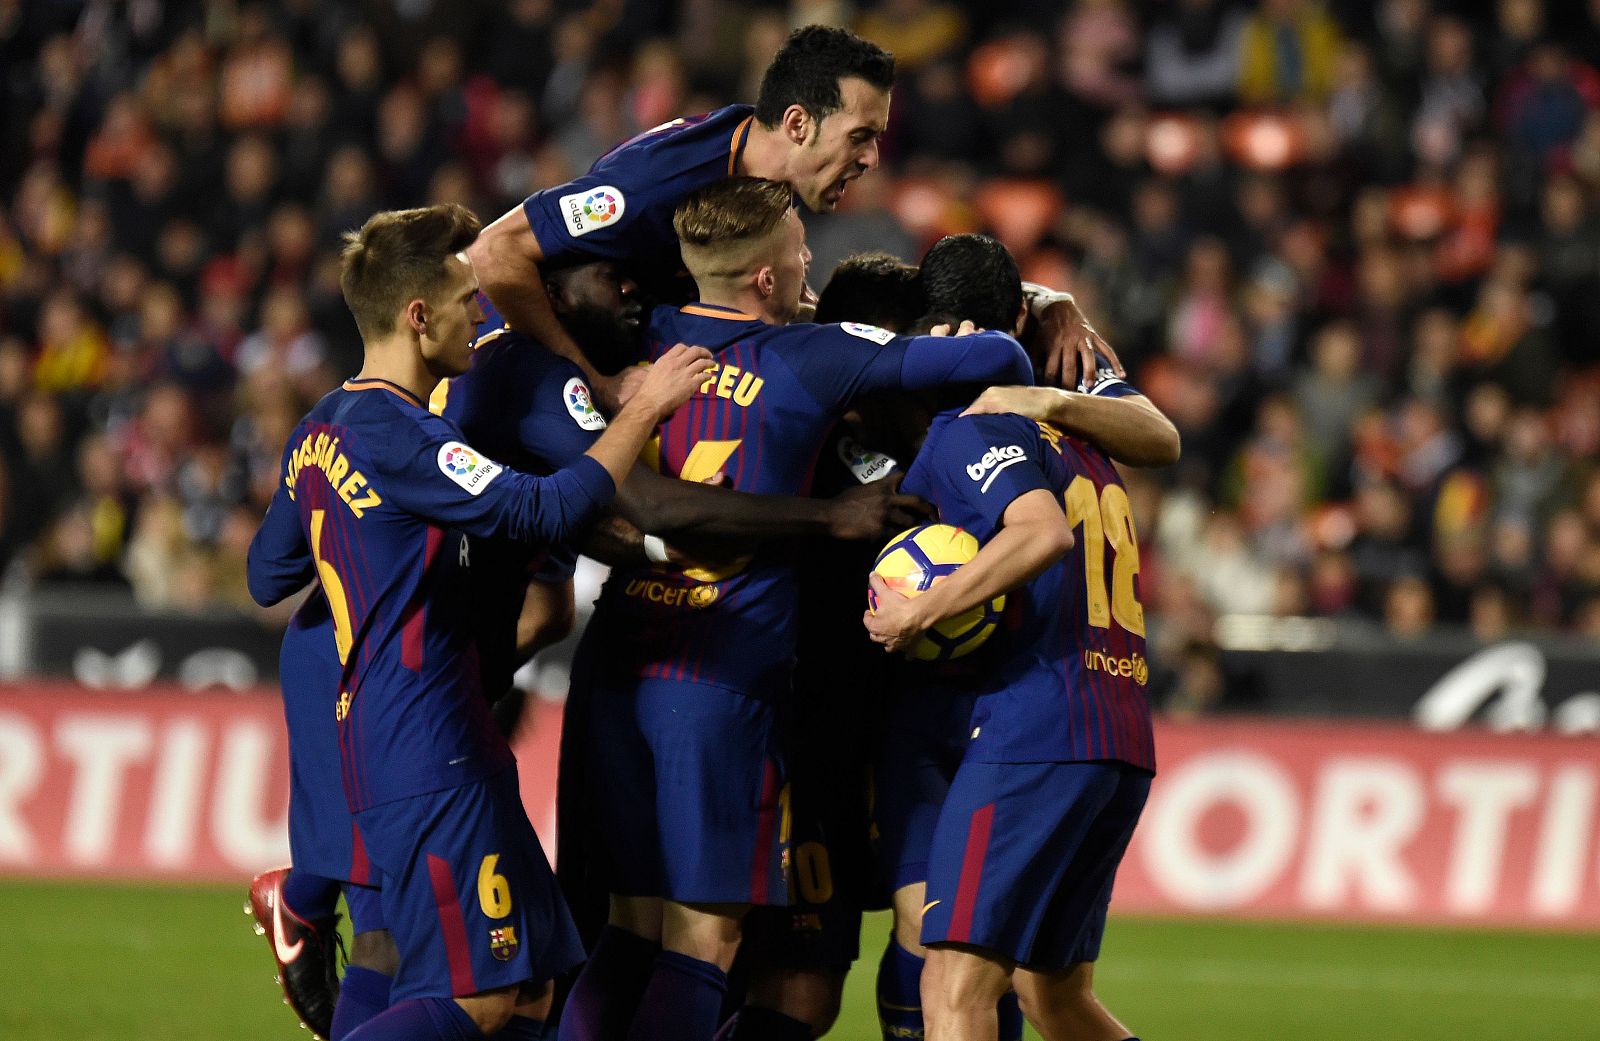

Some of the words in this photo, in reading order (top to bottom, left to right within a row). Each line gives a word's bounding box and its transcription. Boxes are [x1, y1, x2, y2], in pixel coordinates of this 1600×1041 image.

[568, 198, 584, 231] LaLiga
[467, 464, 493, 488] LaLiga
[861, 457, 889, 480] LaLiga
[966, 444, 1024, 482] beko
[477, 853, 512, 920] 6
